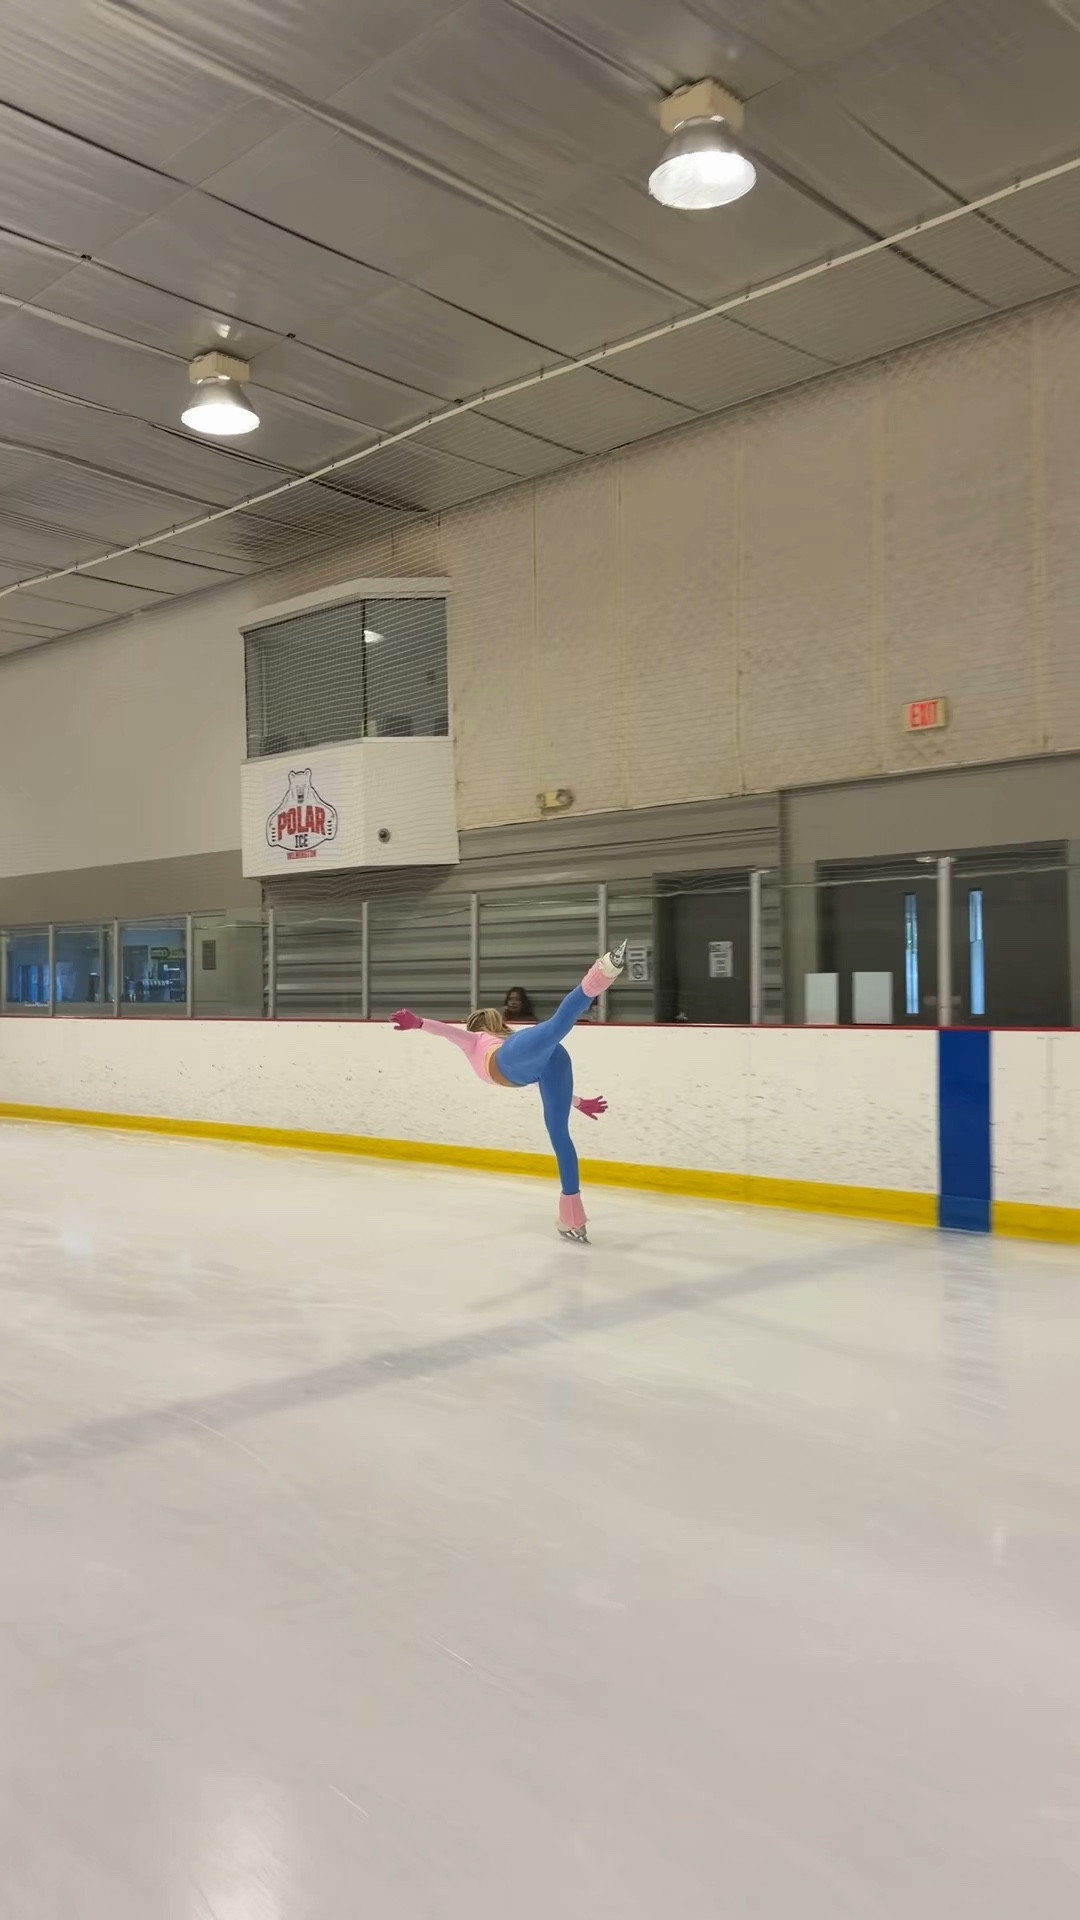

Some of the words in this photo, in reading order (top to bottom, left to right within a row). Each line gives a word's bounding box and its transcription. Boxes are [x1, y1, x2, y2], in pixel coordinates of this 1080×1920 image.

[910, 700, 938, 728] EXIT
[277, 805, 326, 841] POLAR
[294, 833, 308, 848] ICE
